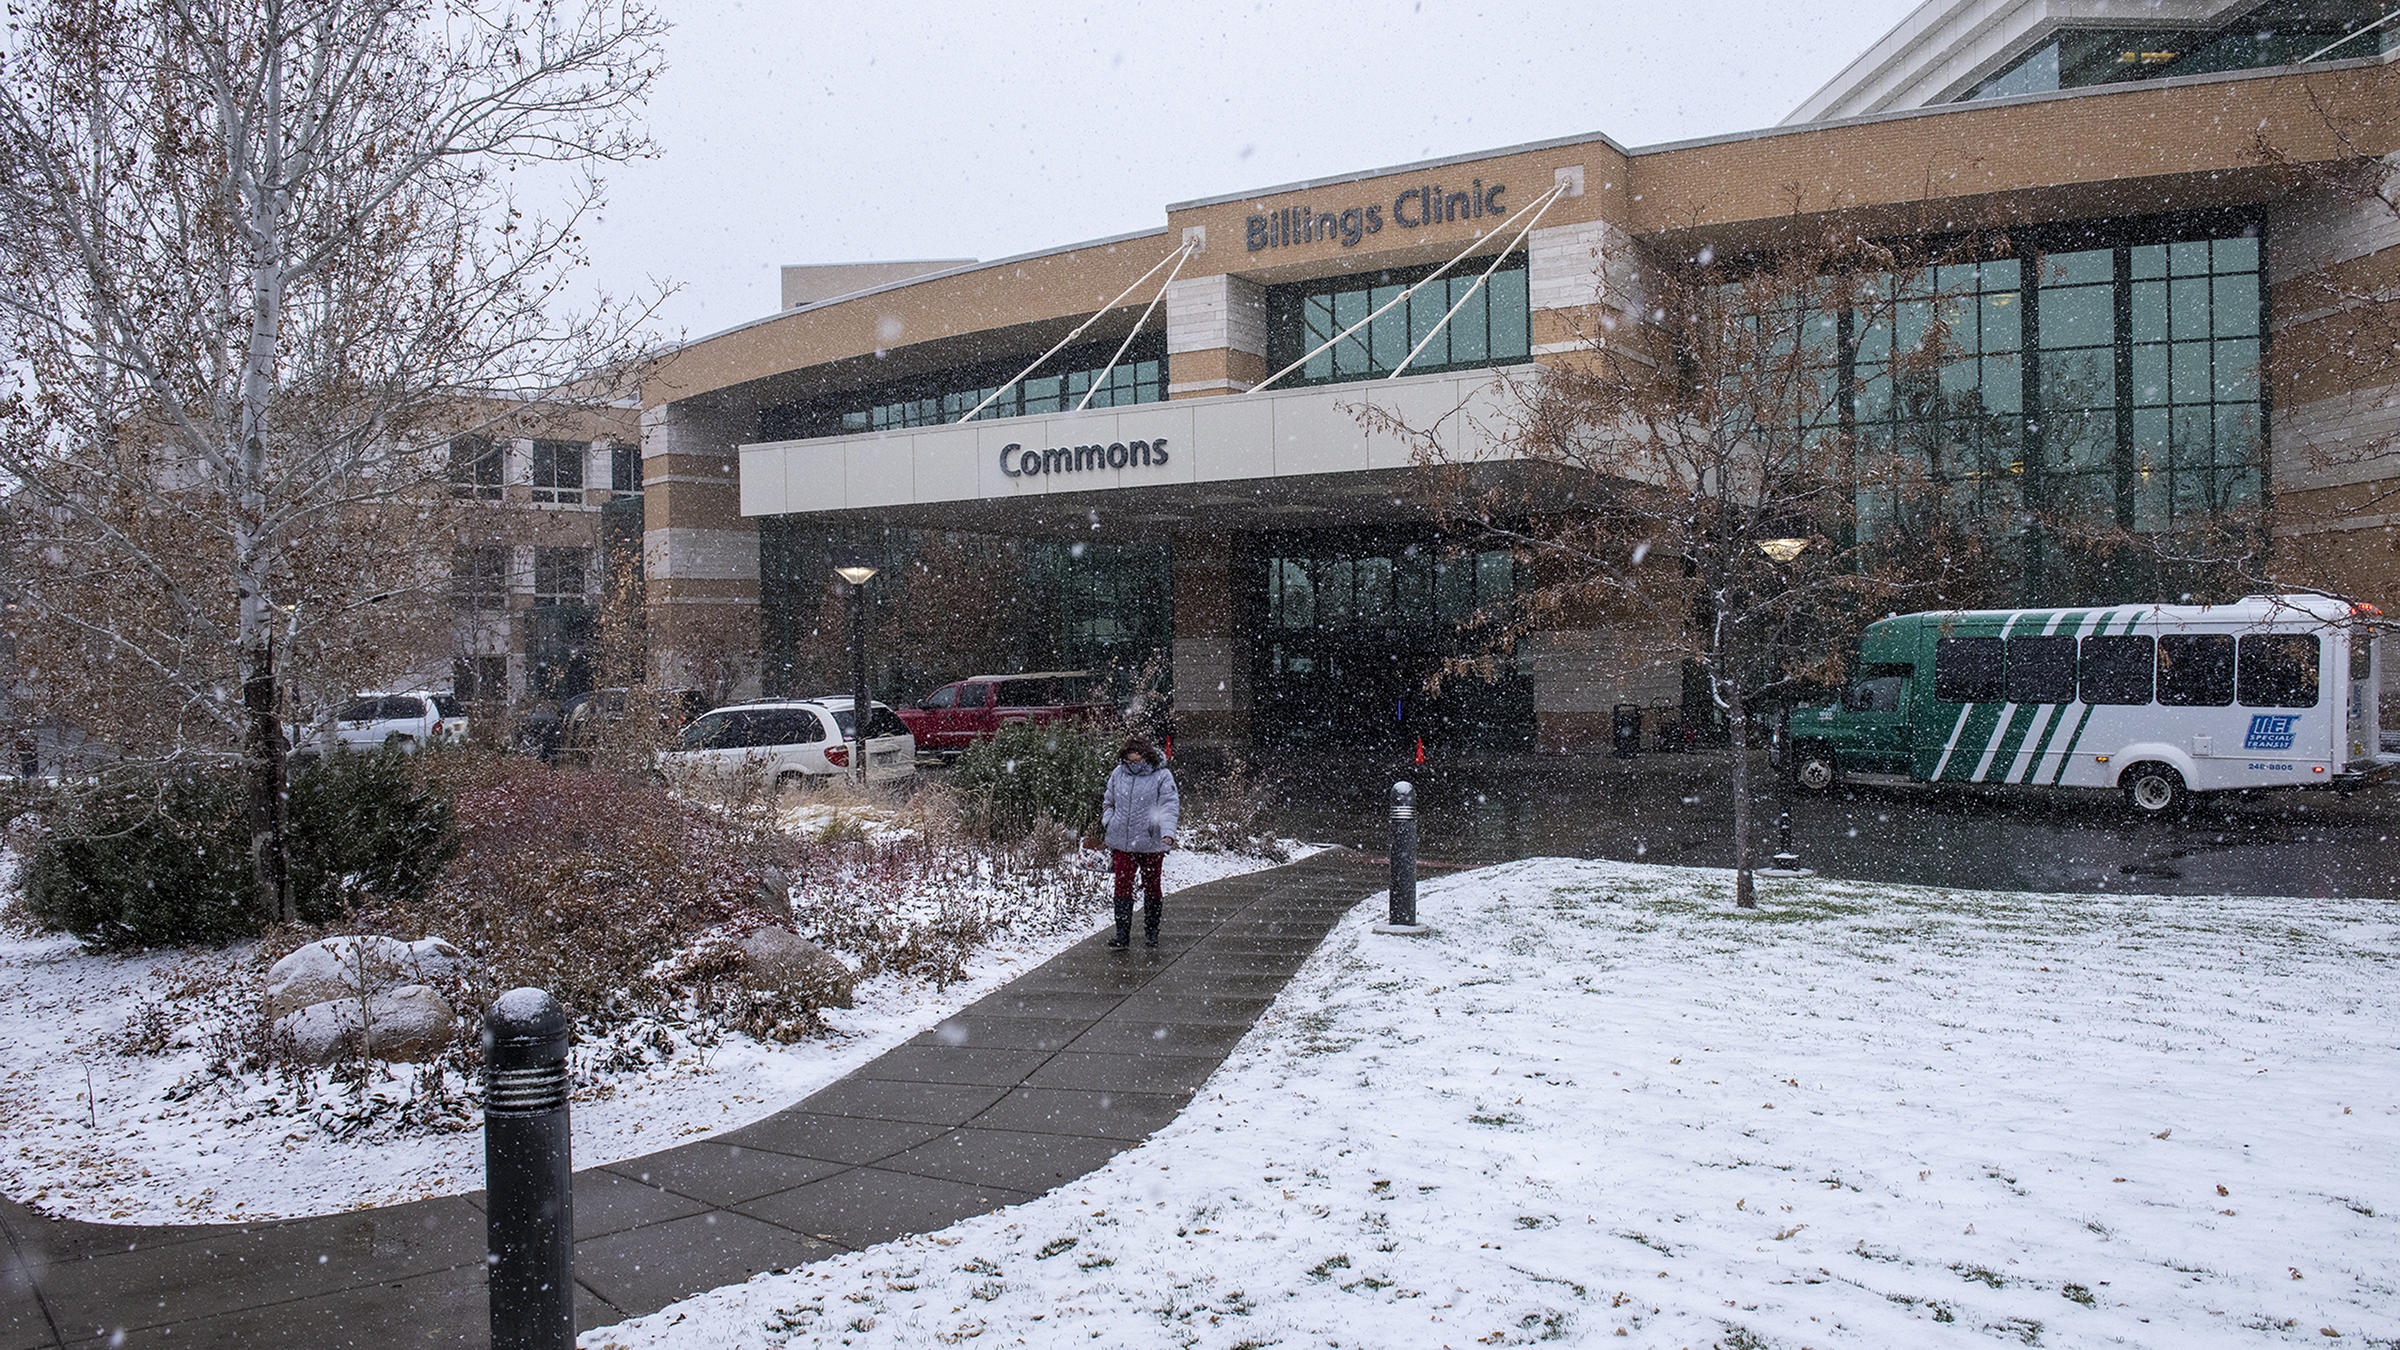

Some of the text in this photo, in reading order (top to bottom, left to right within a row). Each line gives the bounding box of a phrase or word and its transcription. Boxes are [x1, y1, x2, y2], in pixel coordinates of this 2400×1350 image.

[1246, 178, 1506, 251] Billings Clinic
[1000, 438, 1169, 477] Commons
